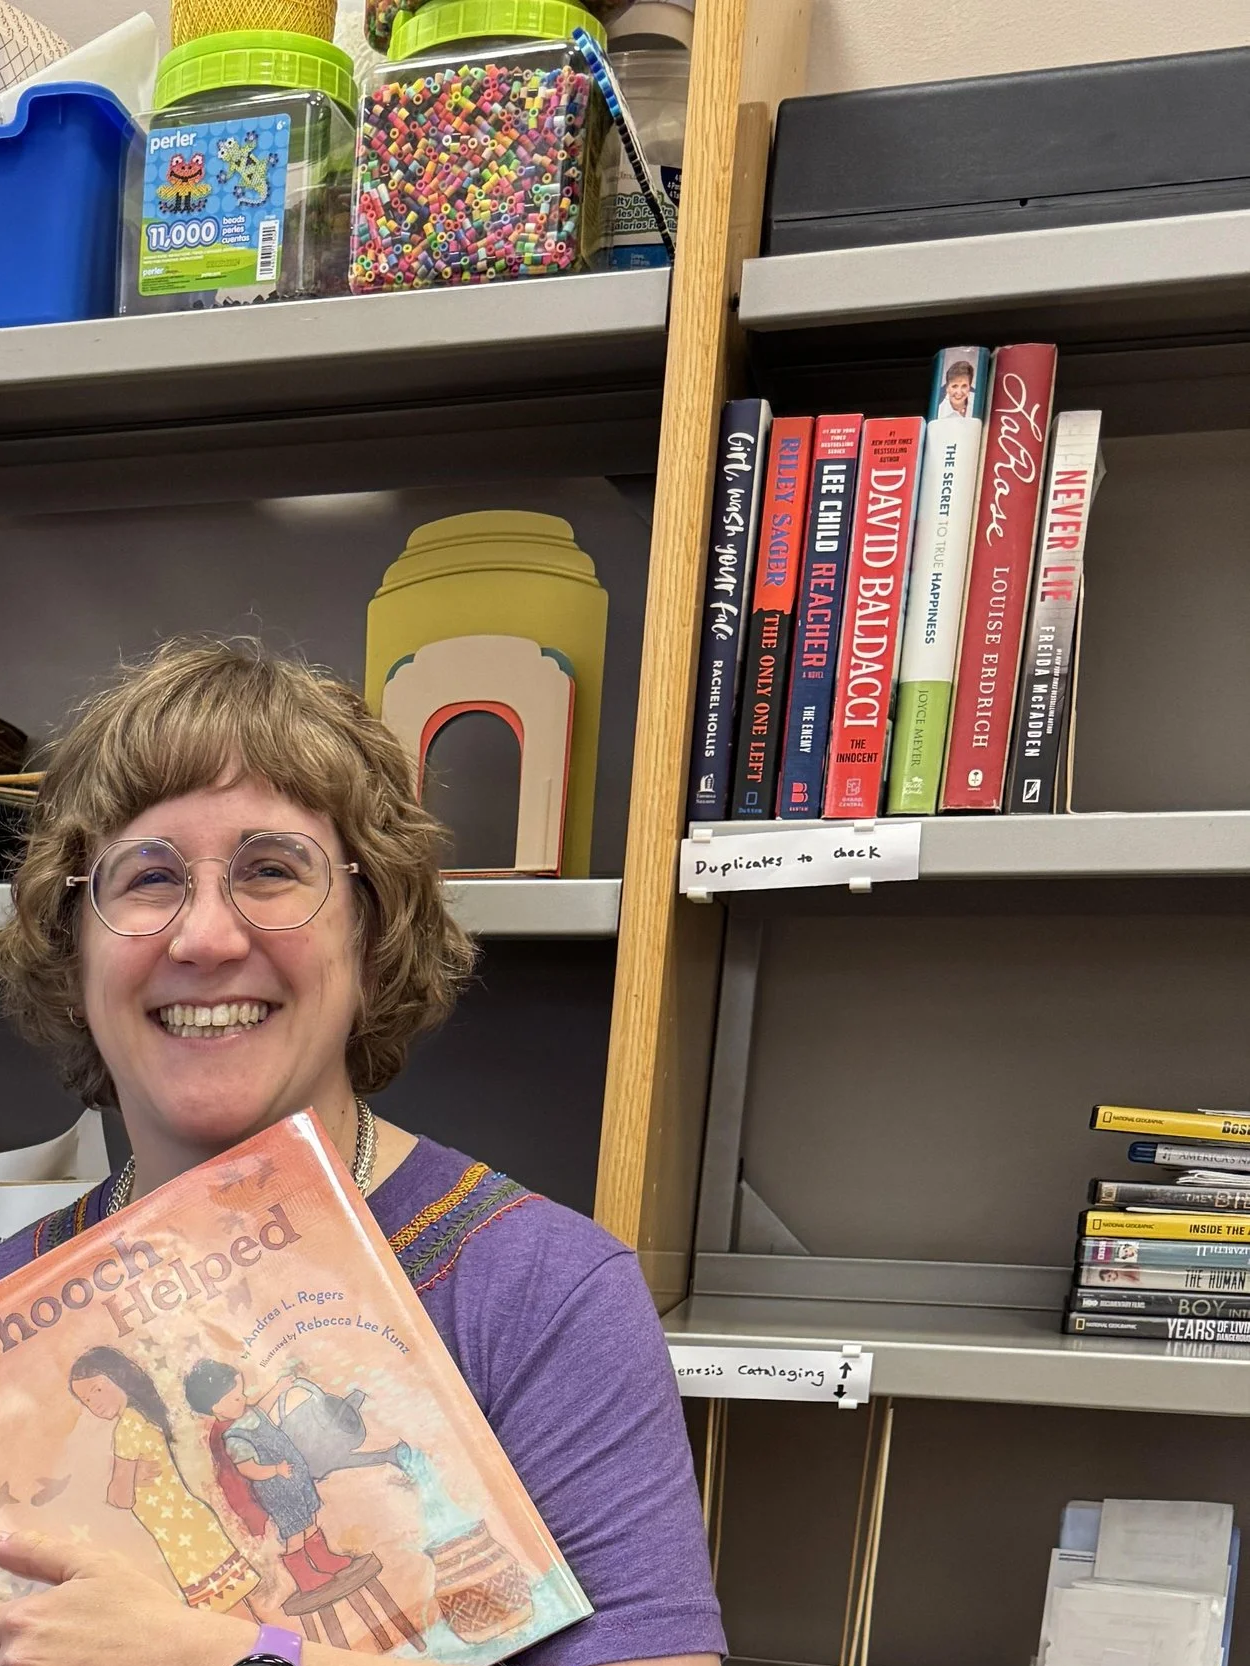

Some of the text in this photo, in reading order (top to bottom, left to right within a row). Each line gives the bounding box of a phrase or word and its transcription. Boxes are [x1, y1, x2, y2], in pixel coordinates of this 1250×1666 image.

[150, 131, 197, 154] perler
[148, 221, 217, 249] 11,000
[221, 235, 250, 244] cuentas
[222, 215, 246, 225] beads
[222, 226, 245, 236] perles
[873, 447, 907, 455] BESTSELLING
[723, 488, 746, 537] wash
[763, 437, 802, 588] RILEY SAGER
[815, 464, 847, 553] LEE CHILD
[924, 443, 957, 645] THE SECRET TO TRUE HAPPINESS
[1040, 470, 1088, 603] NEVER LIE
[714, 544, 738, 597] your
[802, 563, 837, 668] REACHER
[843, 467, 907, 729] DAVID BALDACCI
[972, 566, 1010, 748] LOUISE ERDRICH
[1034, 625, 1056, 677] FREIDA
[704, 660, 724, 758] RACHEL HOLLIS
[746, 614, 780, 783] THE ONLY ONE LEFT
[915, 689, 929, 725] JOYCE
[799, 705, 816, 753] THE ENEMY
[850, 738, 866, 750] THE
[910, 728, 923, 767] MEYER
[836, 752, 879, 764] INNOCENT
[695, 845, 882, 876] Duplicates to check
[1189, 1224, 1245, 1235] INSIDE THE
[100, 1202, 305, 1338] Helped
[1185, 1269, 1247, 1290] THE HUMAN
[243, 1307, 281, 1347] Andrea
[281, 1299, 295, 1311] L.
[297, 1290, 344, 1305] Rogers
[1178, 1298, 1227, 1317] BOY
[295, 1316, 352, 1335] Rebecca
[356, 1315, 379, 1333] Lee
[381, 1325, 411, 1355] Kunz
[1167, 1318, 1216, 1340] YEARS
[1217, 1320, 1229, 1333] OF
[674, 1364, 825, 1387] enesis Cataloging
